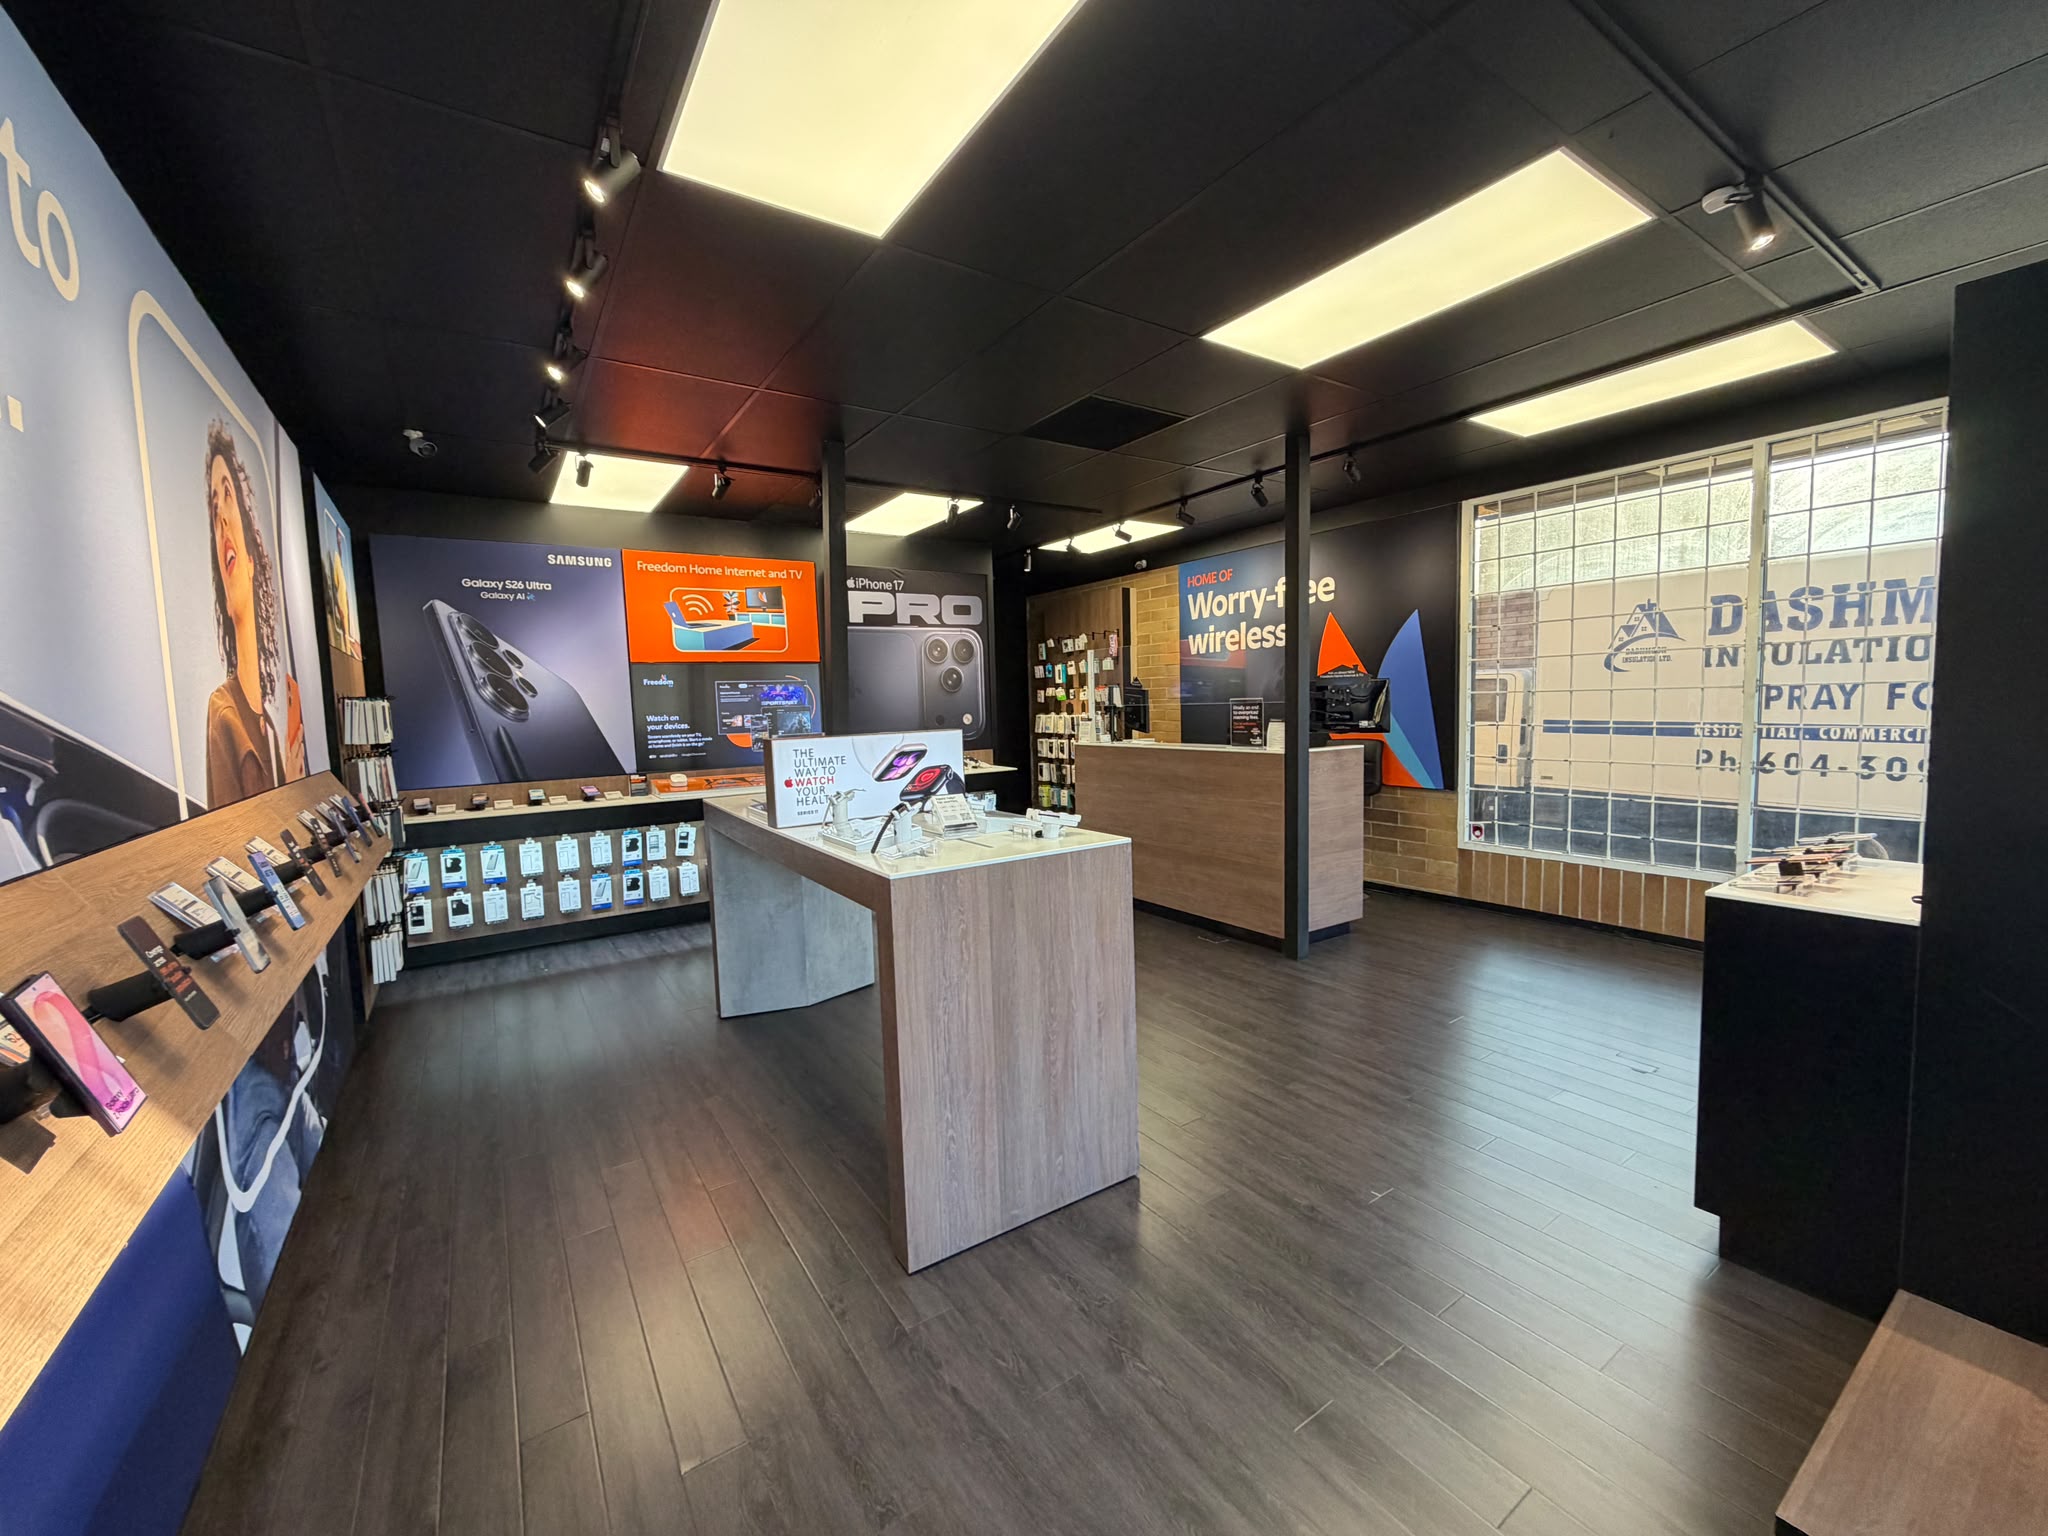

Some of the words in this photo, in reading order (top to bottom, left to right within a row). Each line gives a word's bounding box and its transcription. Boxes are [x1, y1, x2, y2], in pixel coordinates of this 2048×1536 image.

[547, 554, 613, 568] SAMSUNG
[636, 560, 687, 573] Freedom
[689, 564, 722, 576] Home
[724, 566, 765, 578] Internet
[768, 569, 787, 579] and
[788, 570, 803, 580] TV
[461, 578, 503, 591] Galaxy
[505, 580, 524, 590] S26
[525, 581, 552, 591] Ultra
[855, 577, 892, 591] iPhone
[893, 580, 905, 591] 17
[1187, 571, 1217, 588] HOME
[1218, 568, 1233, 582] OF
[480, 591, 515, 601] Galaxy
[516, 591, 526, 600] AI
[847, 590, 983, 625] PRO
[1187, 621, 1287, 655] wireless
[646, 714, 669, 722] Watch
[646, 724, 663, 732] your
[793, 748, 814, 758] THE
[794, 755, 847, 768] ULTIMATE
[794, 767, 818, 778] WAY
[822, 765, 836, 776] TO
[794, 776, 835, 787] WATCH
[796, 785, 826, 797] YOUR
[796, 793, 832, 807] HEALT
